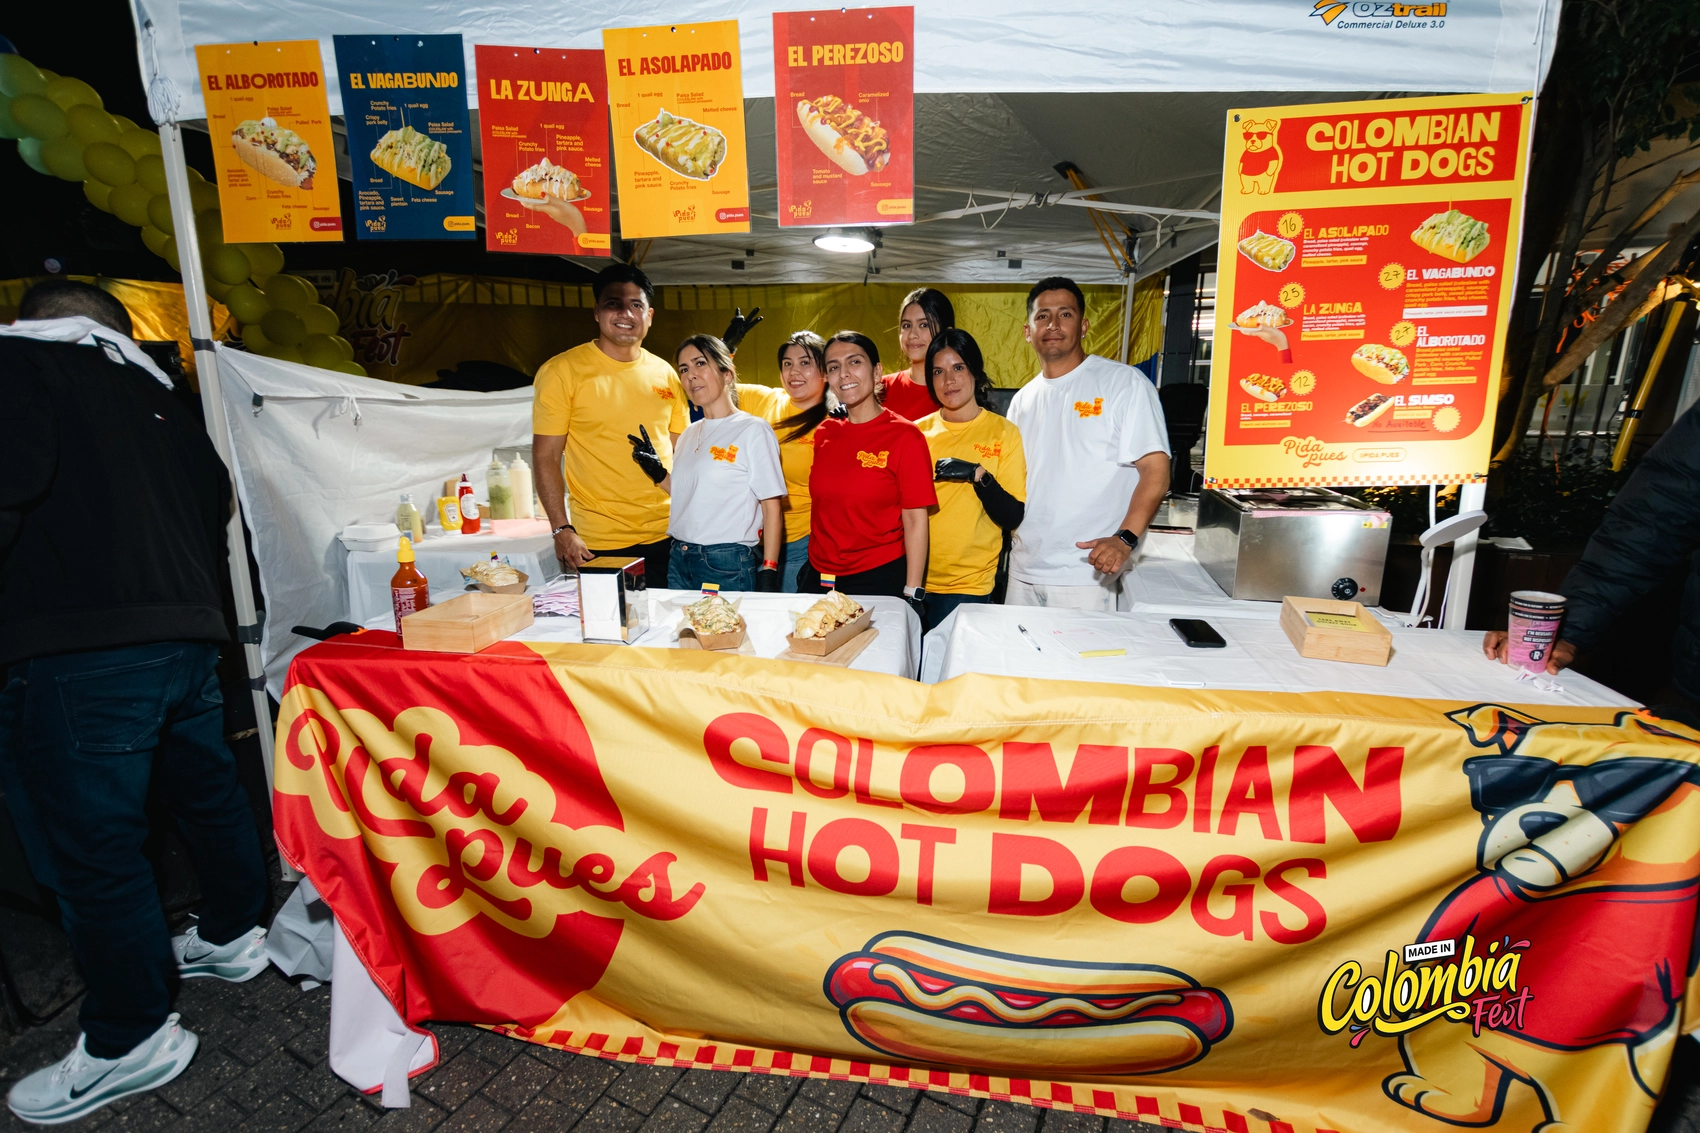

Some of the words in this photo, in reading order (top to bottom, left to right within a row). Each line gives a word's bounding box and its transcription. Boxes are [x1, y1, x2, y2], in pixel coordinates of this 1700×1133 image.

[1396, 20, 1427, 28] Deluxe
[788, 46, 807, 67] EL
[812, 42, 904, 66] PEREZOSO
[618, 59, 635, 76] EL
[640, 52, 732, 75] ASOLAPADO
[208, 75, 222, 90] EL
[226, 72, 319, 90] ALBOROTADO
[350, 74, 365, 89] EL
[368, 72, 458, 88] VAGABUNDO
[490, 79, 513, 100] LA
[517, 81, 595, 102] ZUNGA
[1306, 112, 1500, 151] COLOMBIAN
[1330, 152, 1394, 183] HOT
[1400, 146, 1495, 180] DOGS
[1282, 217, 1296, 234] 16
[1304, 228, 1315, 239] EL
[1318, 225, 1389, 238] ASOLAPADO
[1384, 270, 1401, 281] 27
[1407, 270, 1418, 280] EL
[1422, 266, 1495, 279] VAGABUNDO
[1282, 287, 1300, 302] 25
[1304, 304, 1316, 315] LA
[1319, 302, 1362, 314] ZUNGA
[1395, 326, 1411, 340] 27
[1417, 326, 1429, 336] EL
[1416, 335, 1485, 347] ALBOROTADO
[1294, 375, 1310, 388] 12
[1241, 403, 1251, 413] EL
[1254, 402, 1313, 412] PEREZOSO
[1394, 395, 1406, 406] EL
[1284, 440, 1324, 458] Pida
[1303, 451, 1347, 468] pues
[1533, 651, 1540, 659] R
[285, 707, 528, 839] Pida
[703, 712, 1405, 844] COLOMBIAN
[416, 828, 706, 921] pues
[748, 806, 957, 907] HOT
[988, 831, 1327, 945] DOGS
